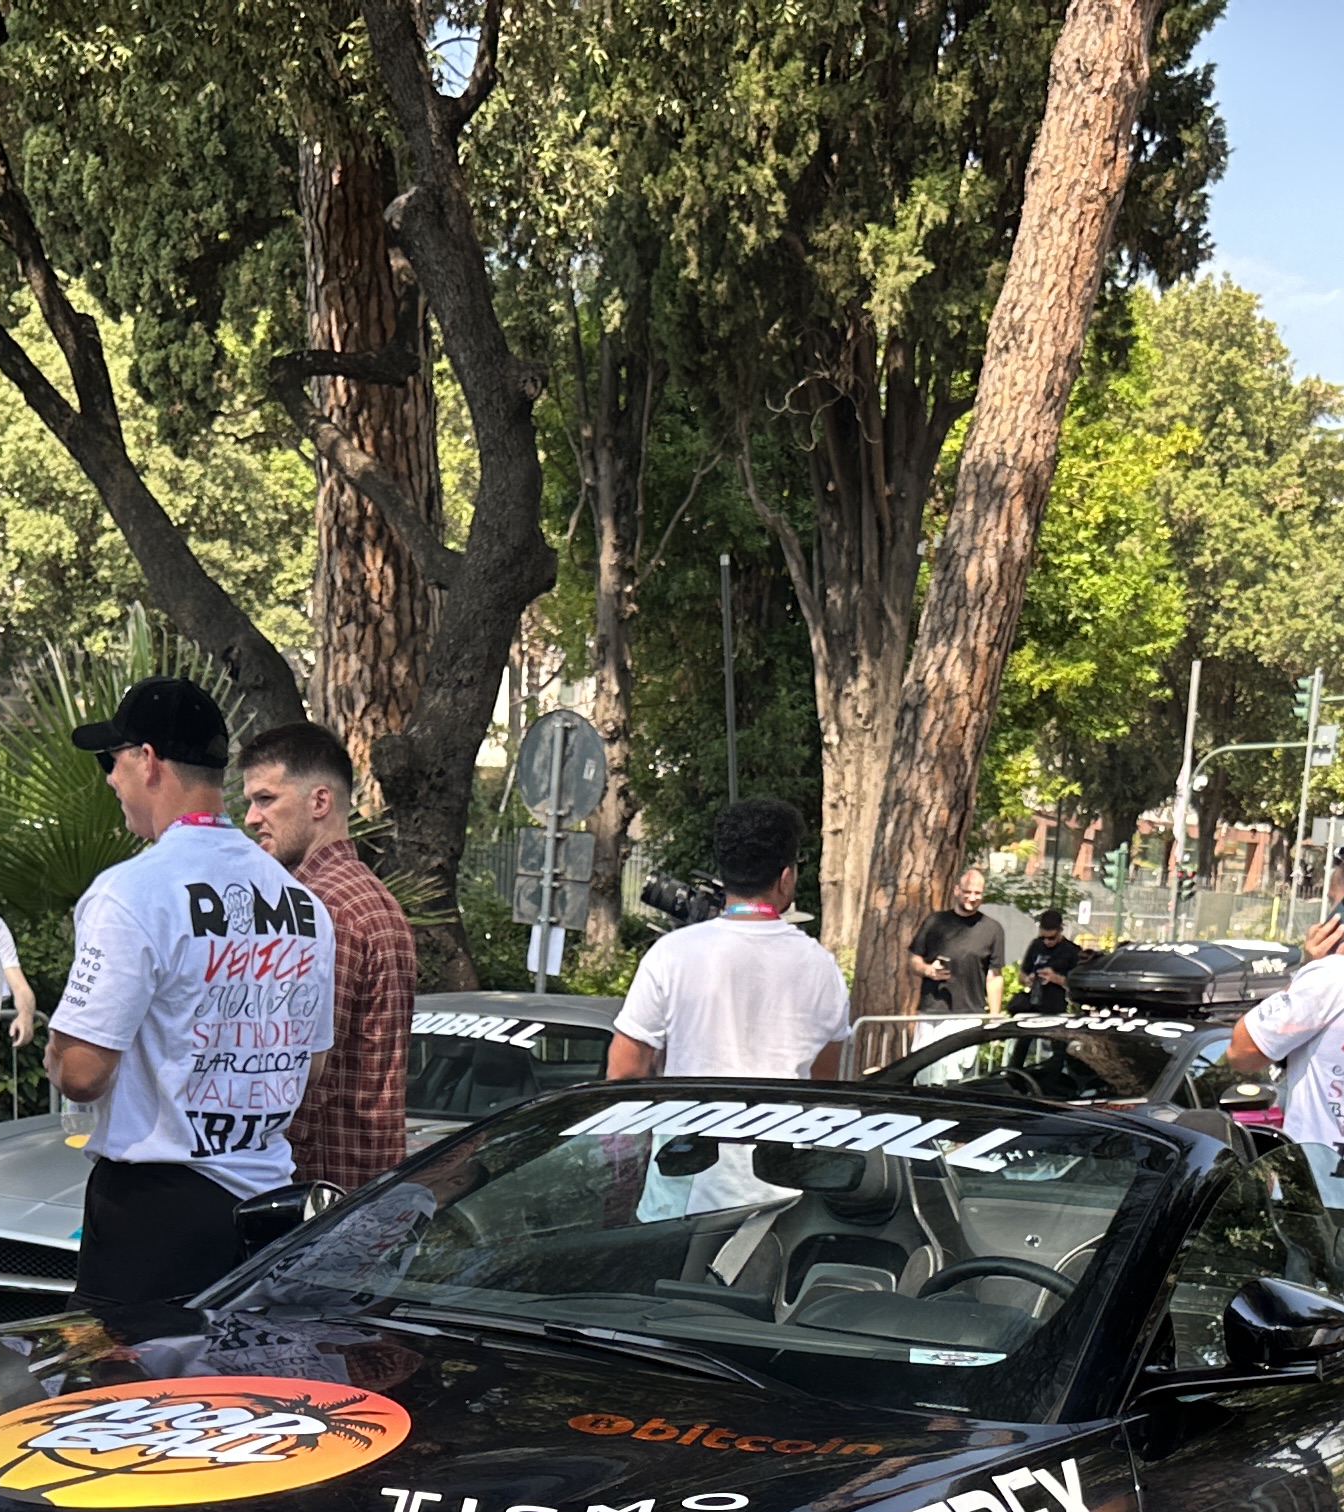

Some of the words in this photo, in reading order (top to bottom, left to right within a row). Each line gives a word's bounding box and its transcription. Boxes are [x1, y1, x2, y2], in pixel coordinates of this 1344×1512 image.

[559, 1101, 1023, 1173] MODBALL
[53, 1399, 328, 1435] MOD
[27, 1422, 291, 1463] BALL
[630, 1418, 883, 1456] bitcoin
